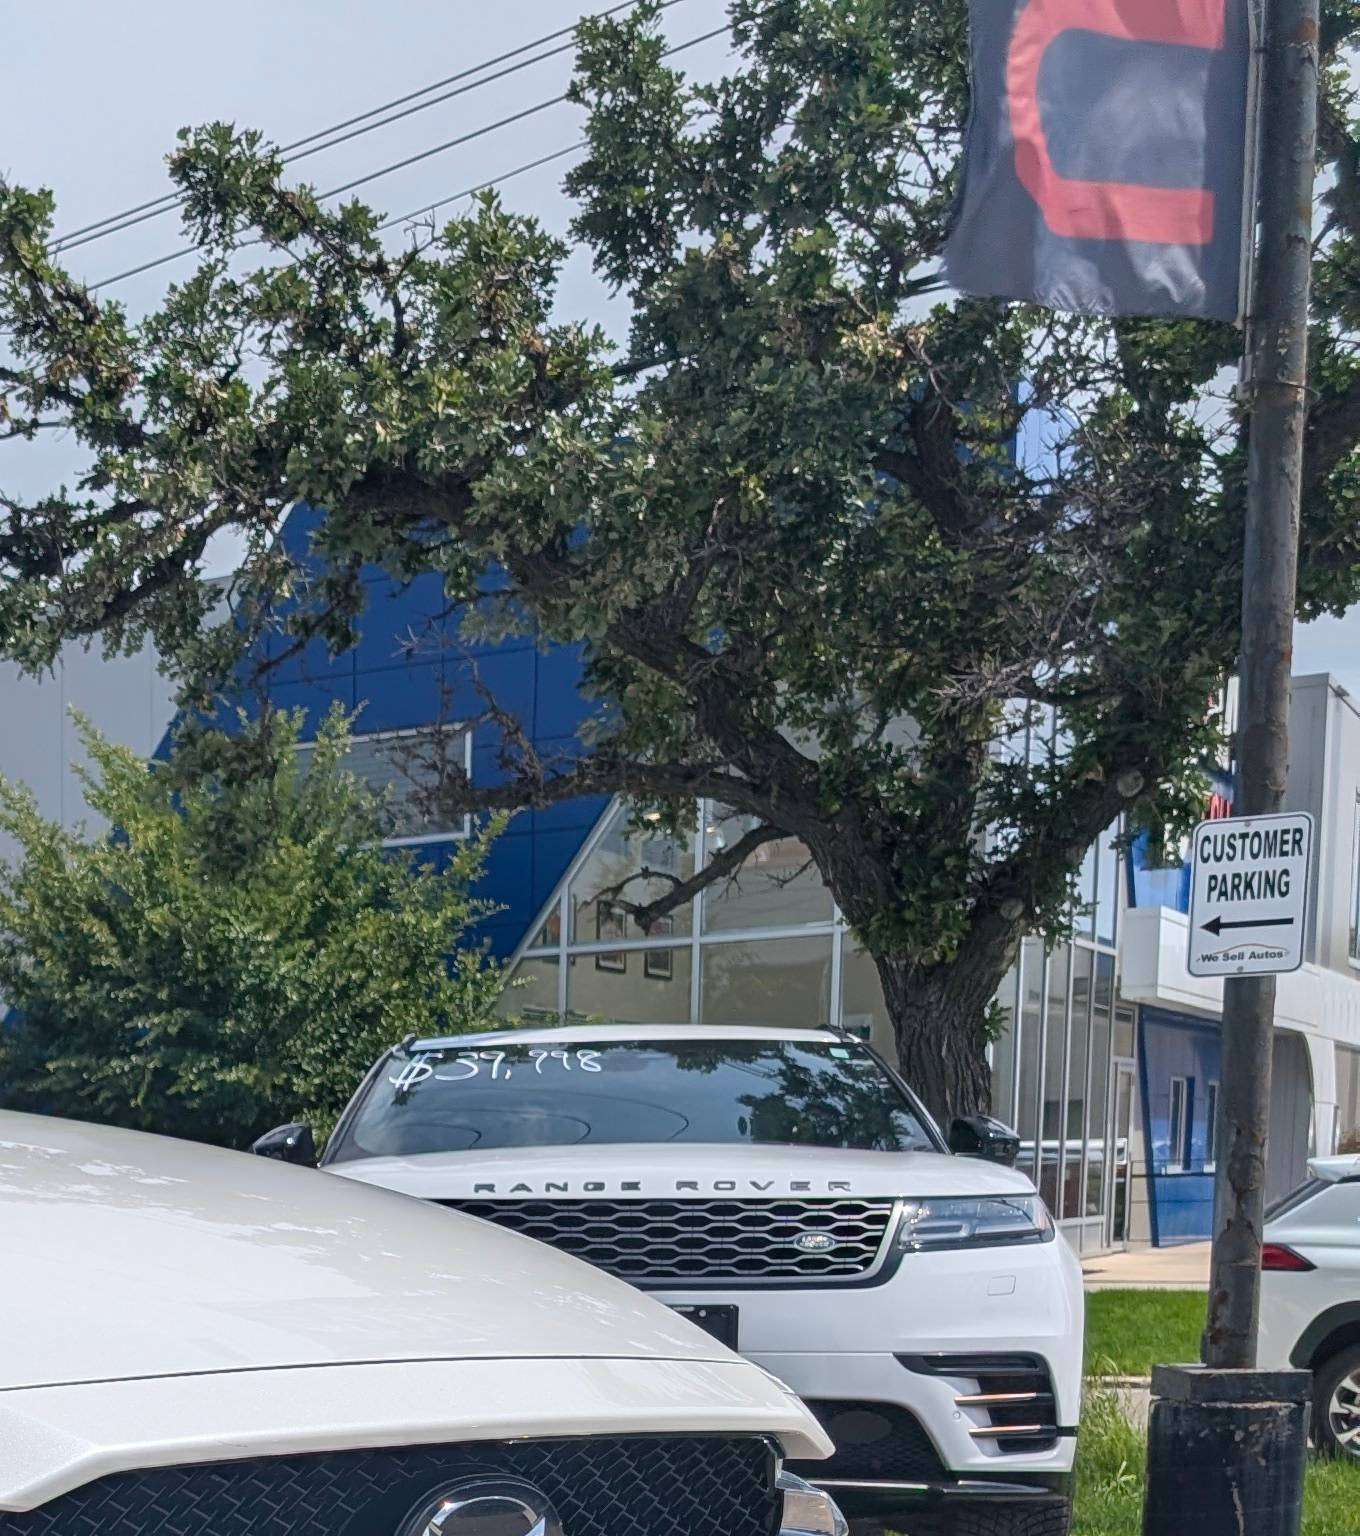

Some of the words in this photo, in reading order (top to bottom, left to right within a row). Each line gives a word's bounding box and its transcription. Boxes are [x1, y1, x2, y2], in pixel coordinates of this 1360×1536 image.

[1200, 828, 1304, 864] CUSTOMER
[1207, 868, 1291, 903] PARKING
[1201, 953, 1220, 962] We
[1222, 952, 1245, 962] Sell
[1249, 951, 1284, 960] Autos
[473, 1181, 642, 1194] RANGE
[675, 1180, 852, 1193] ROVER
